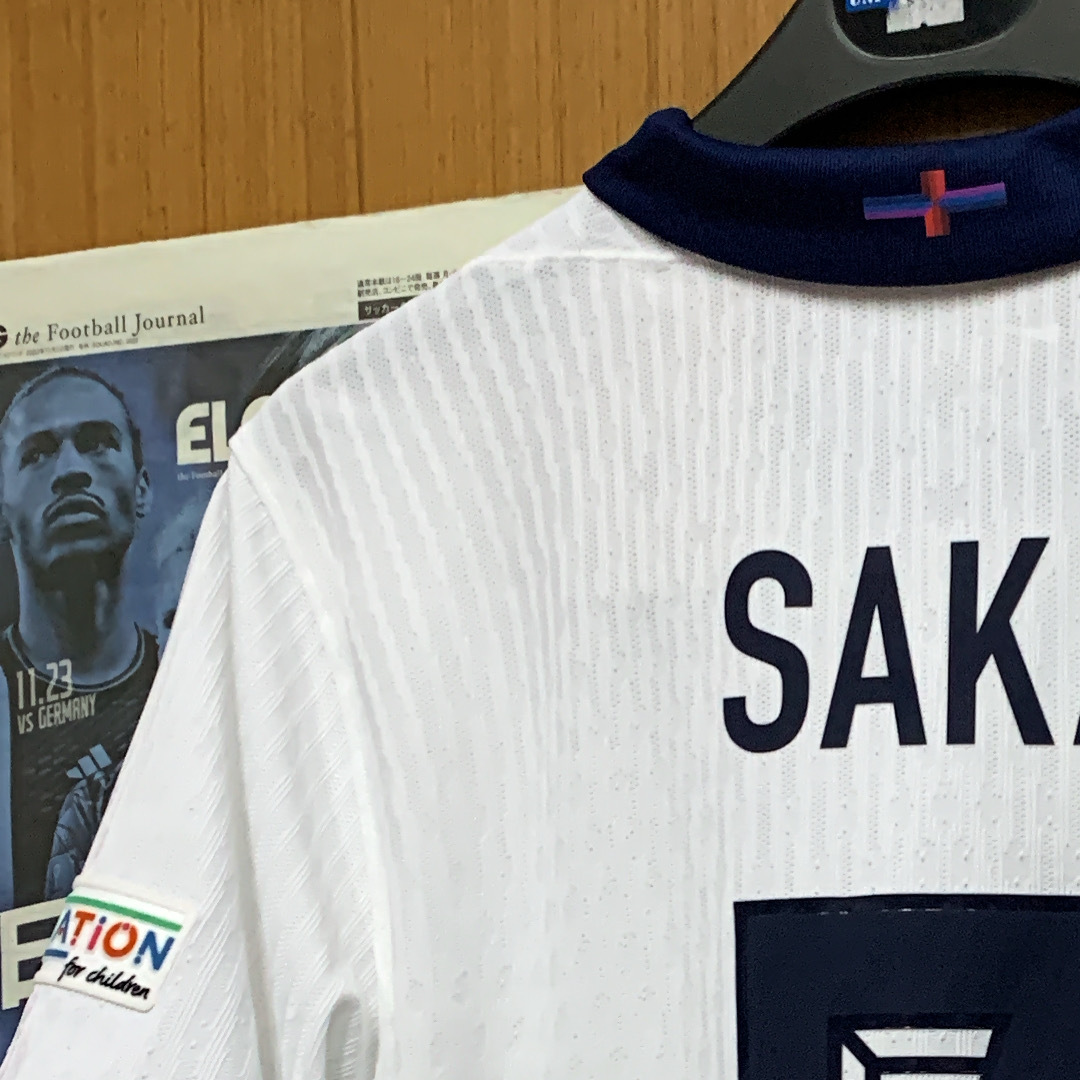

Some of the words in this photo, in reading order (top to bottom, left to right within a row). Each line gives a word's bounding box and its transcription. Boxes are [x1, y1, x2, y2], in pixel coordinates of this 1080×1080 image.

[15, 326, 40, 346] the
[47, 315, 127, 342] Football
[131, 305, 205, 337] Journal
[16, 658, 74, 710] 11.23
[17, 711, 34, 735] VS
[38, 692, 97, 730] GERMANY
[57, 956, 86, 982] for
[86, 966, 150, 1000] children
